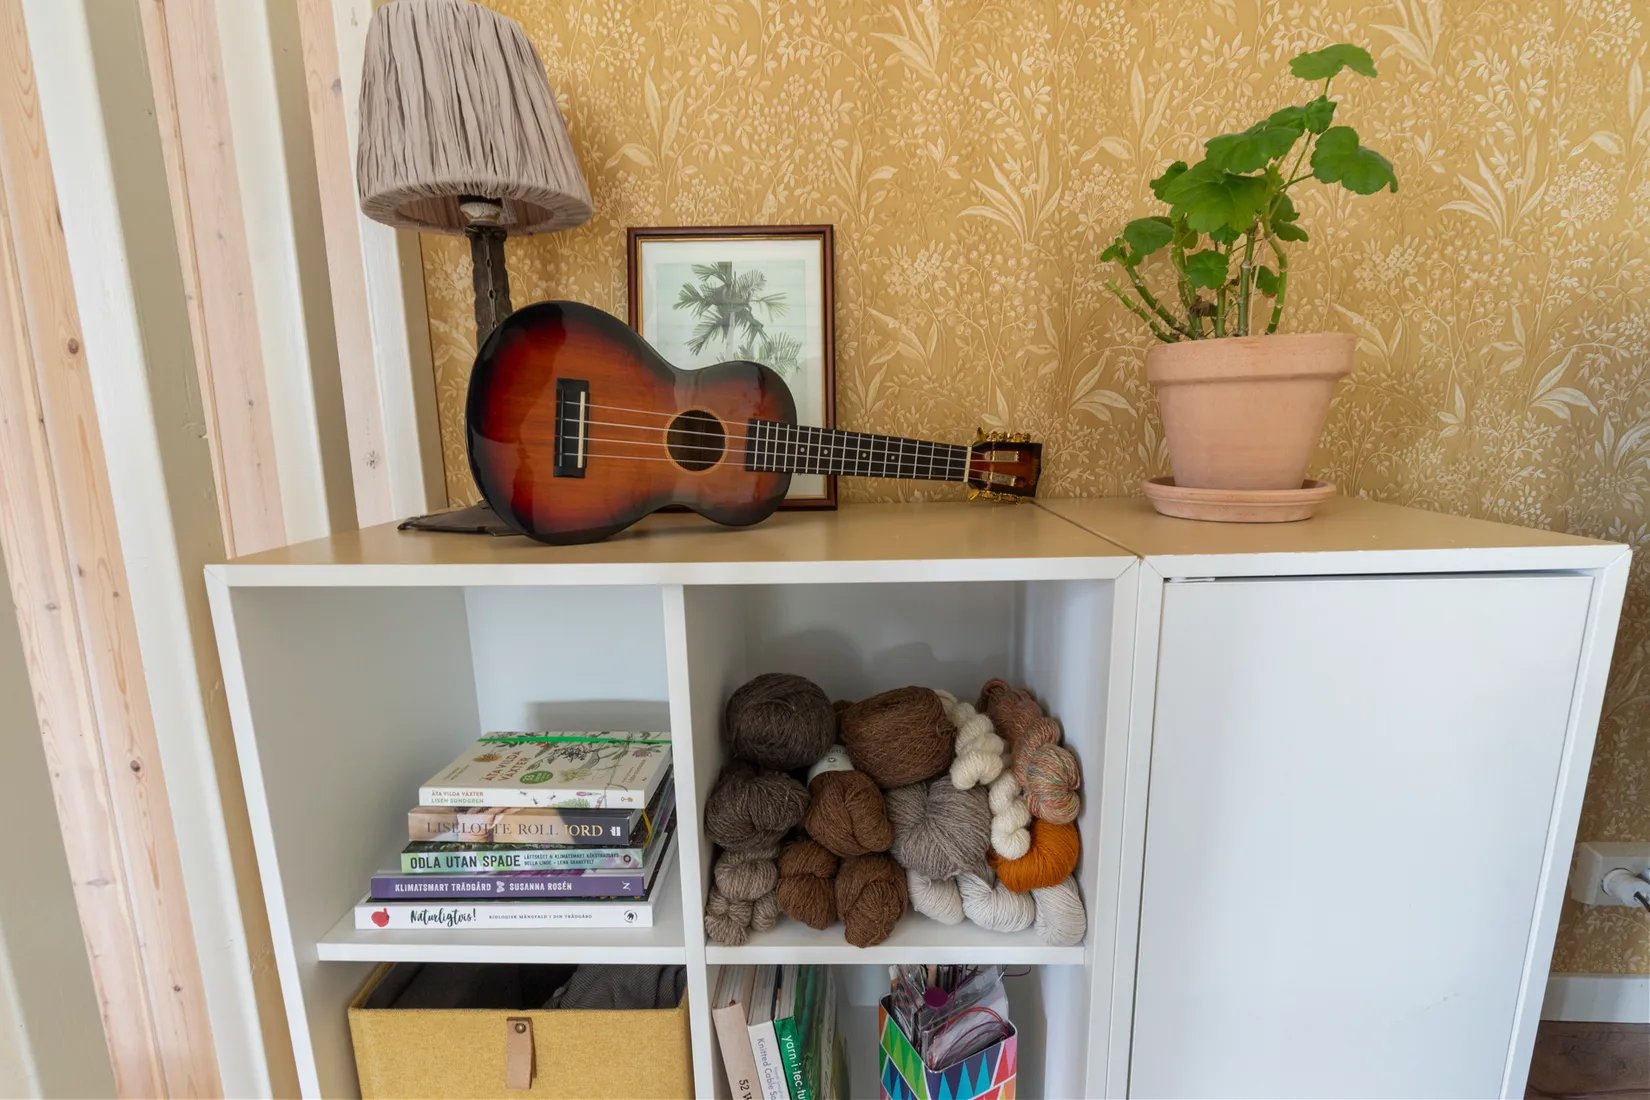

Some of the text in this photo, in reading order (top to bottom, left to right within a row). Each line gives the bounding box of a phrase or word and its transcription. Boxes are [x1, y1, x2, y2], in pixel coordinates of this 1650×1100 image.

[427, 821, 513, 835] LISELOTTE
[518, 823, 560, 836] ROLL
[410, 855, 521, 869] ODLA UTAN SPADE
[395, 881, 573, 892] KLIMATSMART TRÄDGÅRD SUSANNA ROSÉN
[410, 907, 477, 928] Naturligtvis!
[757, 1037, 772, 1067] Knitted
[739, 1079, 750, 1091] 52
[764, 1067, 776, 1090] Cable
